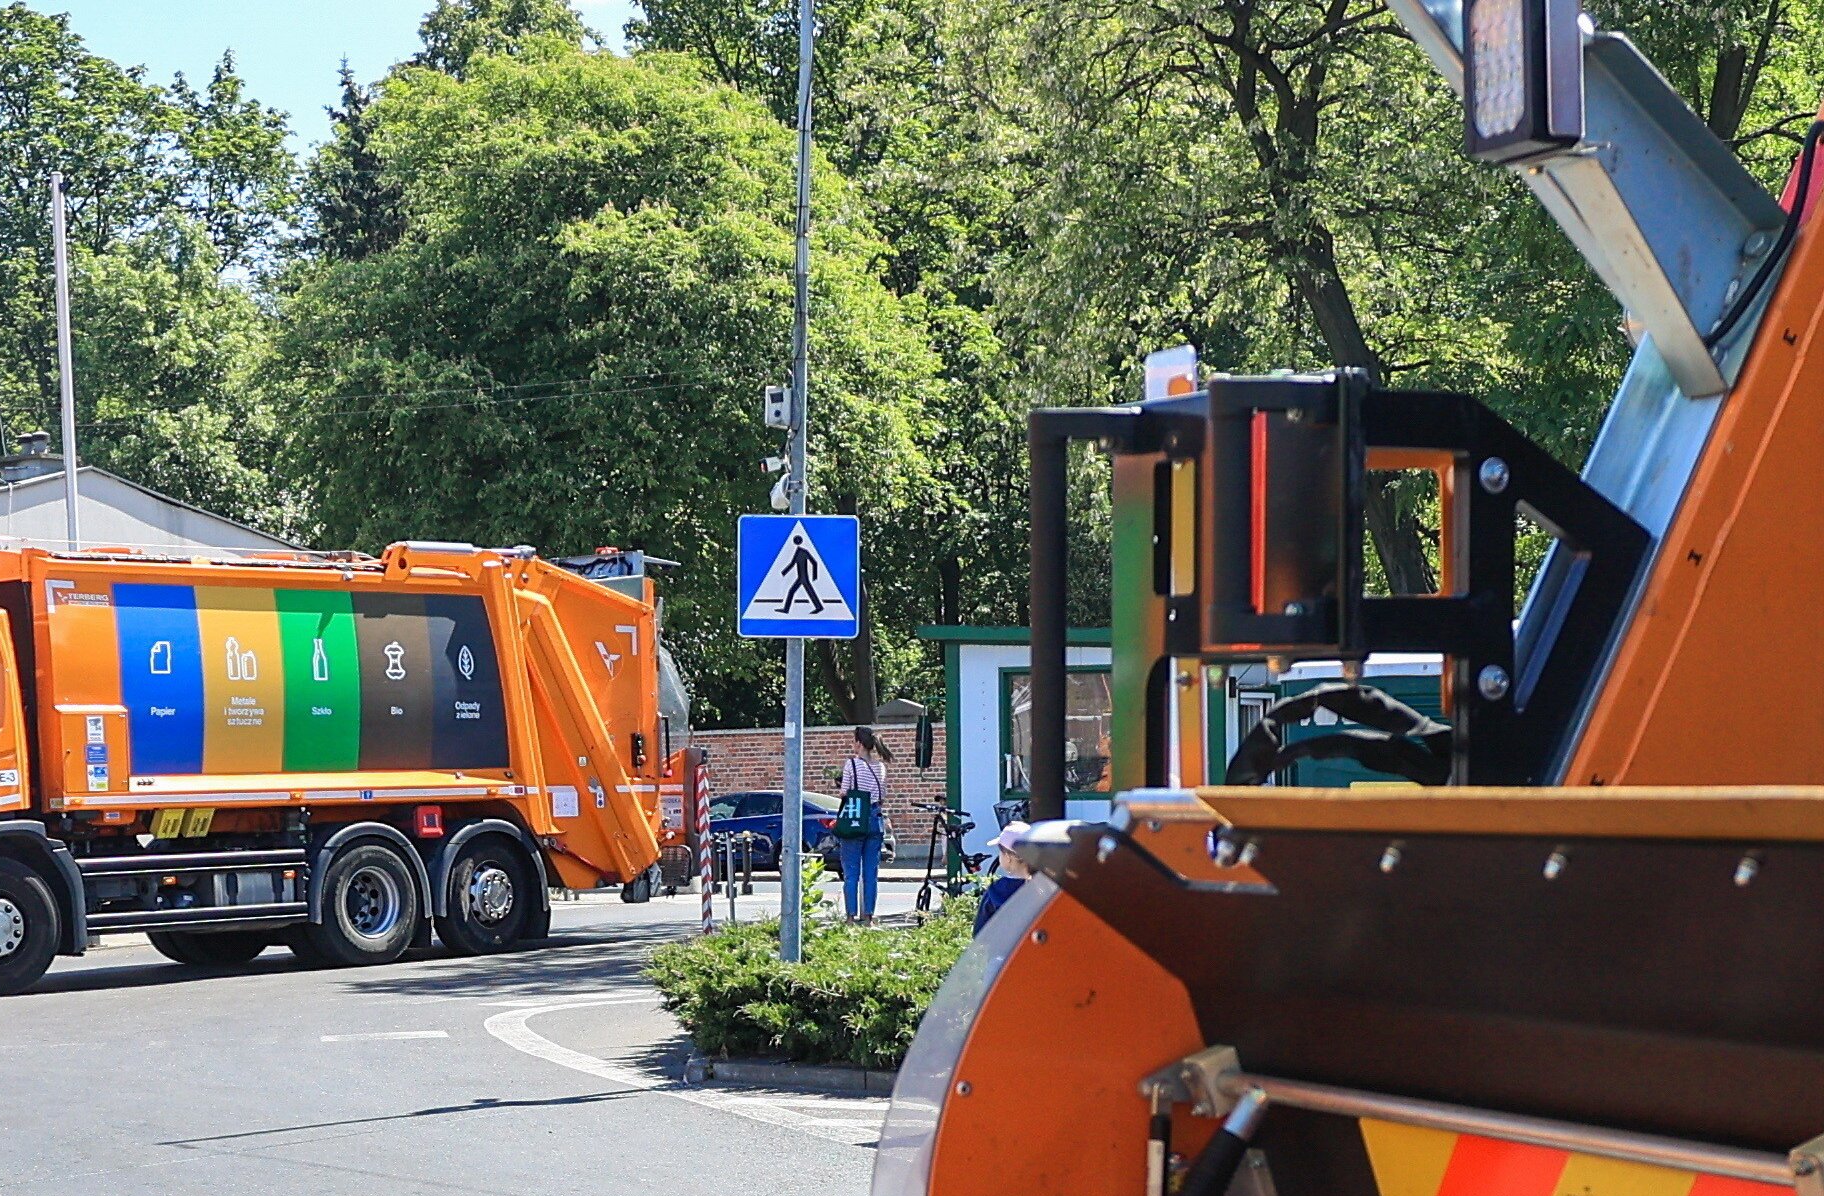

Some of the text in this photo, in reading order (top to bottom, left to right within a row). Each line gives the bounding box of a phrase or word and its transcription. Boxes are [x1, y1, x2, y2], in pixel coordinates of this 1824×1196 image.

[390, 707, 404, 715] Bio
[455, 701, 480, 711] Odpady
[150, 707, 176, 717] Papier
[455, 711, 480, 719] zielone
[0, 772, 16, 782] E-3
